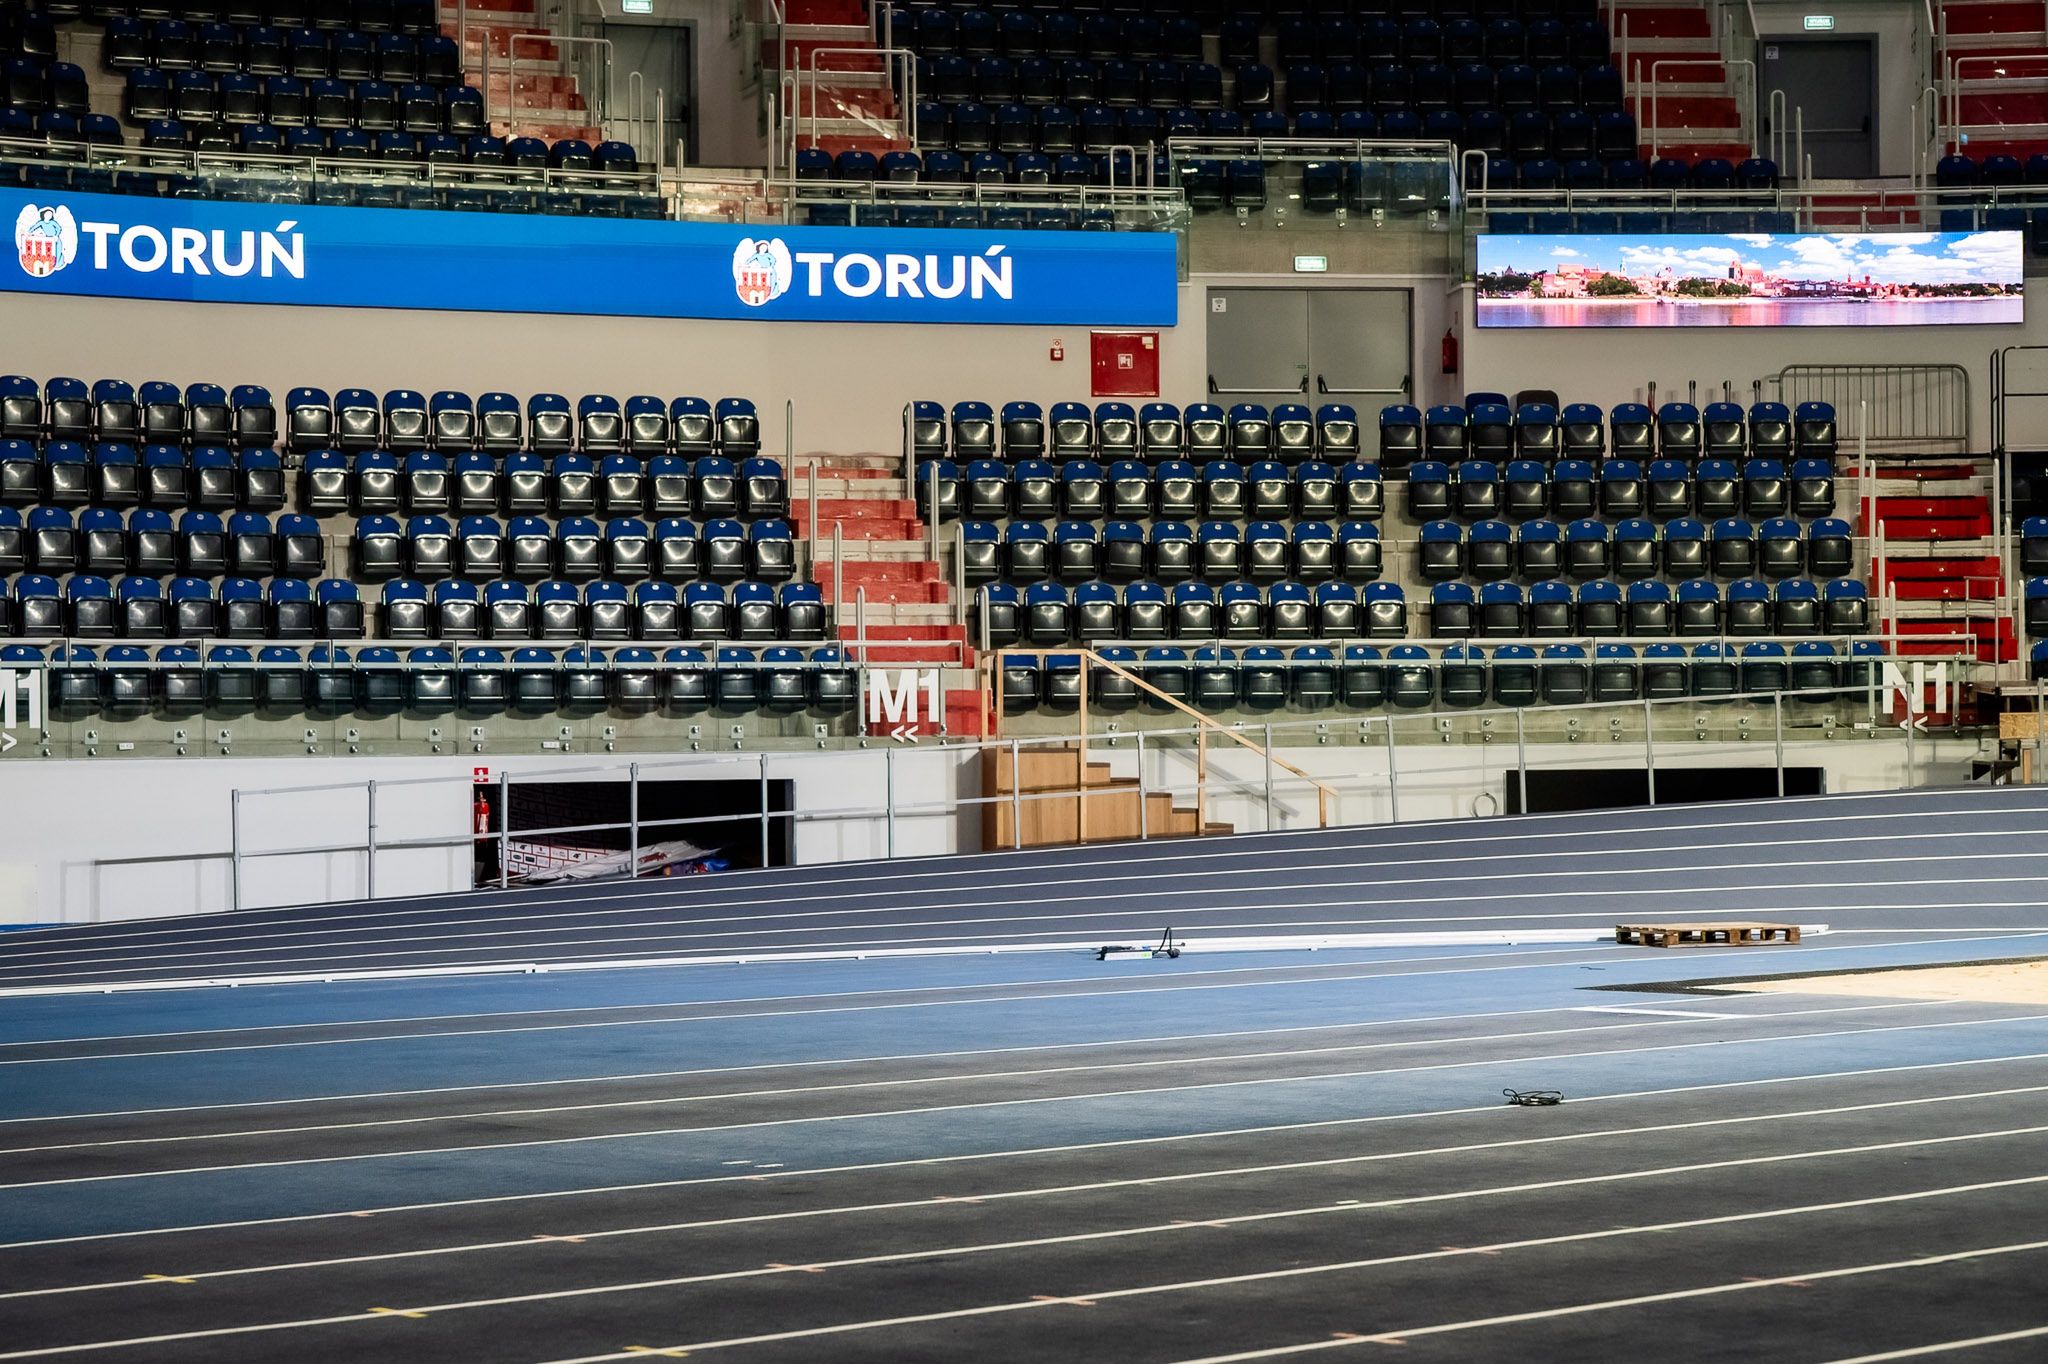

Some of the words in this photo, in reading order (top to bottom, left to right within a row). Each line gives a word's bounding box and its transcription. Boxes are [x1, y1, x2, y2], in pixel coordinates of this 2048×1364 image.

[82, 220, 305, 279] TORUŃ
[795, 245, 1013, 300] TORUŃ
[869, 668, 940, 723] M1
[1882, 661, 1947, 714] N1
